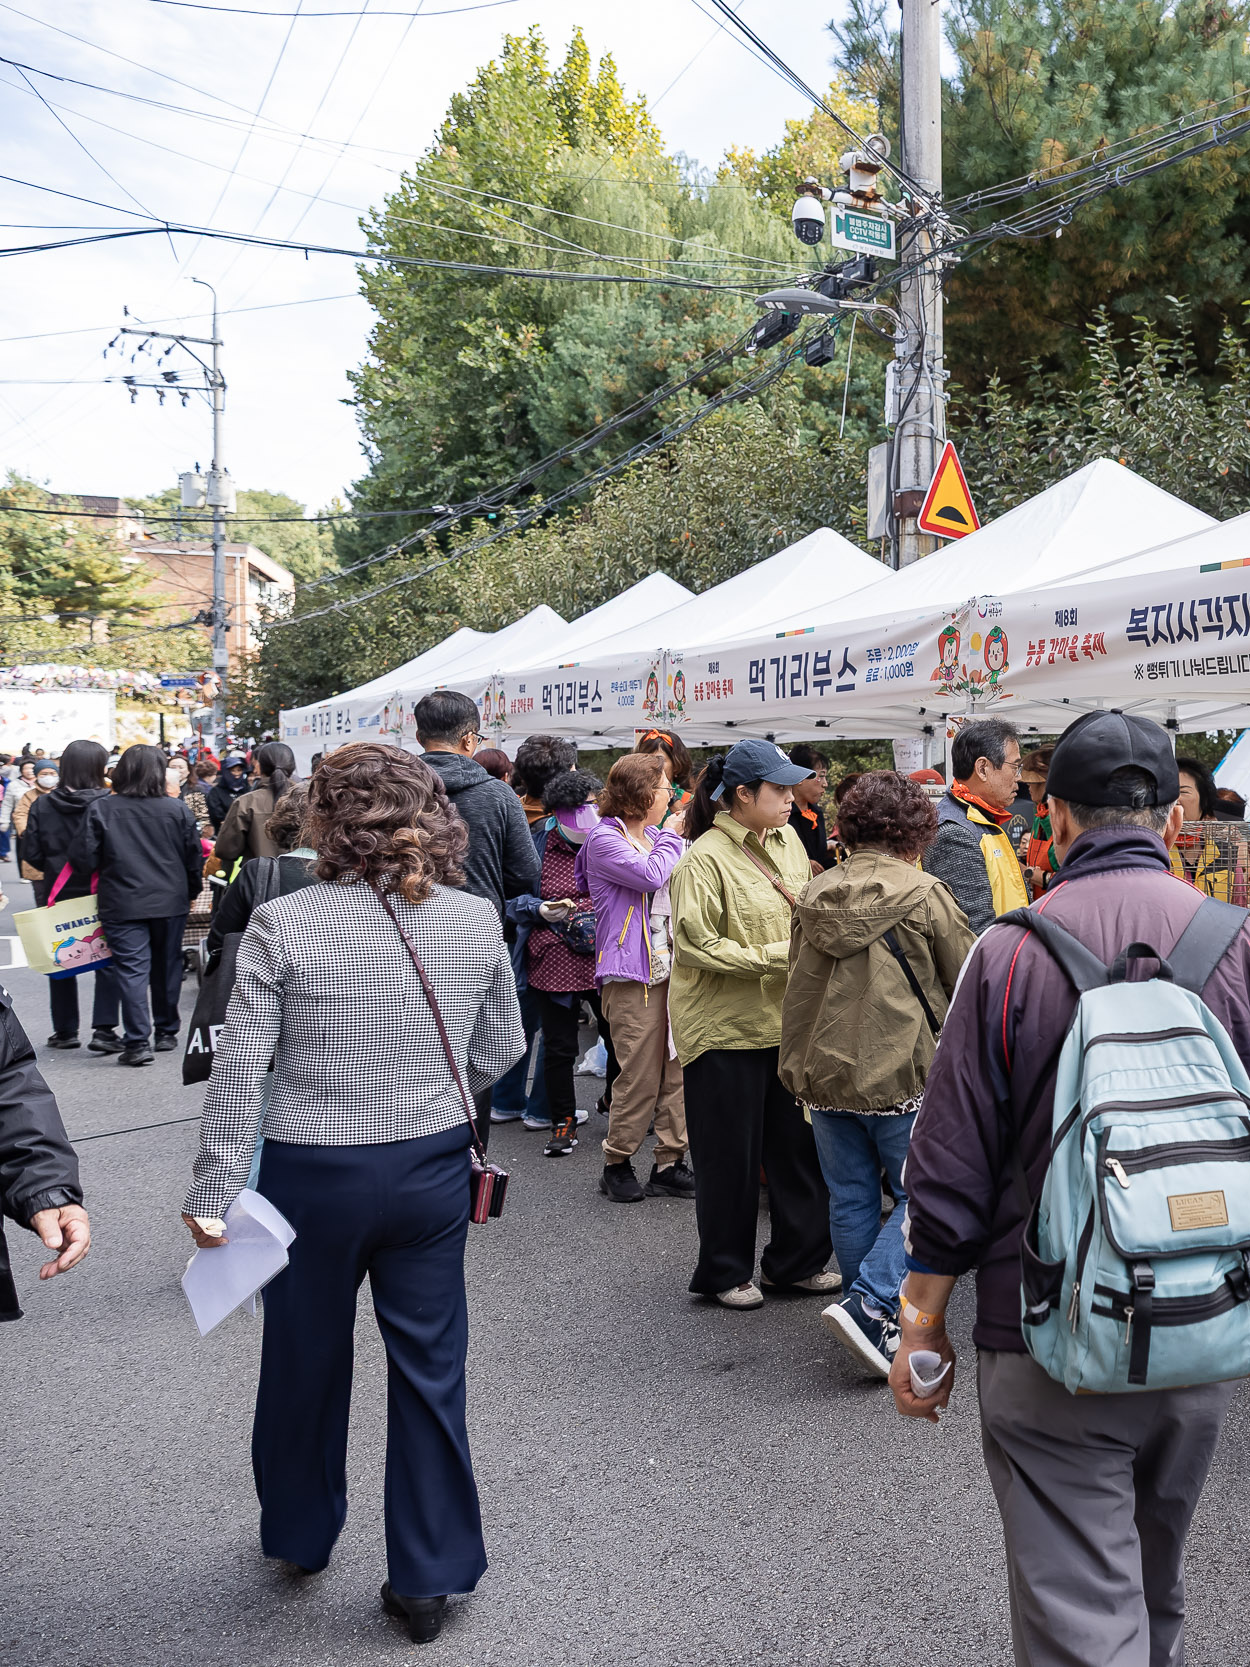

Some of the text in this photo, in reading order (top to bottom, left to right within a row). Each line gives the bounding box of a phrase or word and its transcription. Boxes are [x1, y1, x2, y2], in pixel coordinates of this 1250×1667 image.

[850, 226, 868, 236] CCTV
[1054, 607, 1078, 628] 제8회
[1025, 631, 1108, 667] 능동 감마을 축제
[748, 646, 858, 702] 먹거리부스
[1146, 660, 1180, 680] 뻥튀기
[542, 679, 603, 717] 먹거리부스
